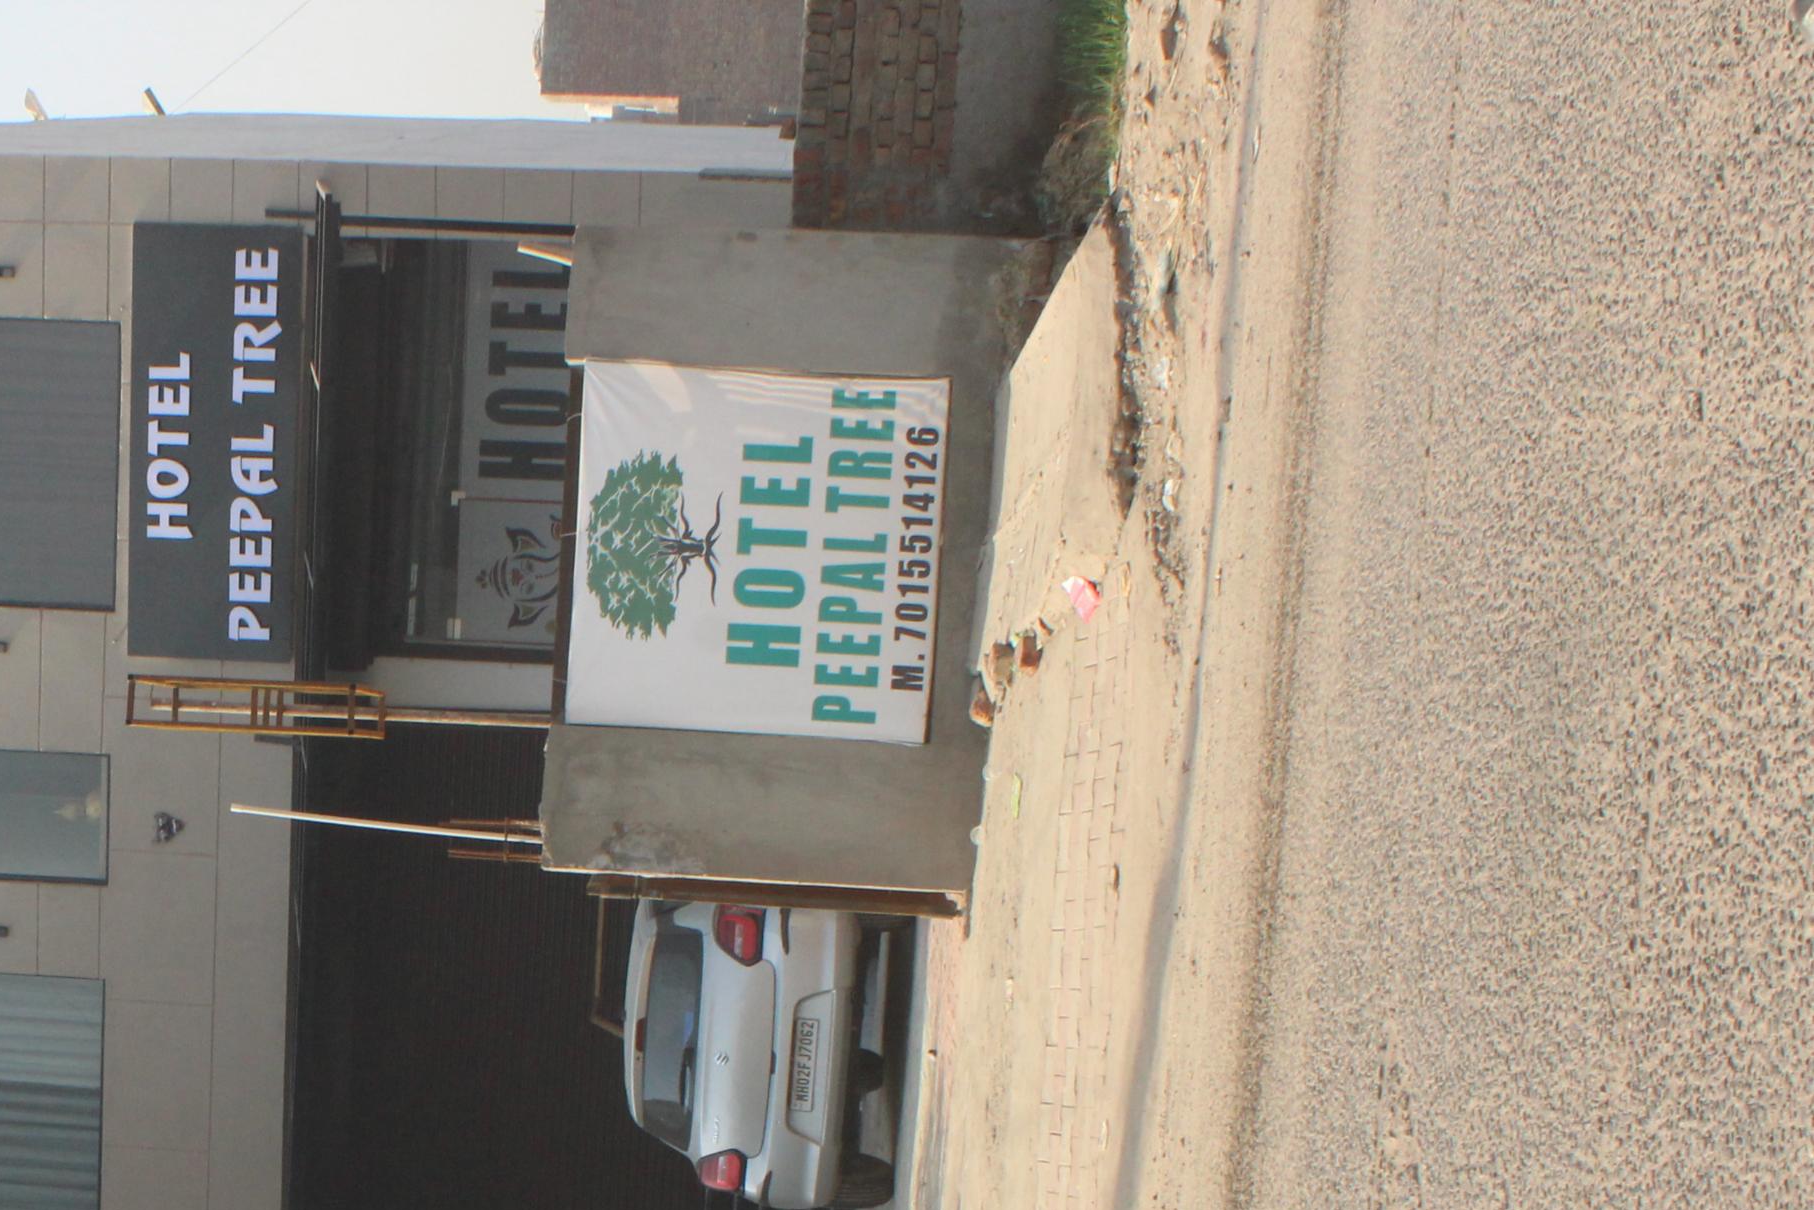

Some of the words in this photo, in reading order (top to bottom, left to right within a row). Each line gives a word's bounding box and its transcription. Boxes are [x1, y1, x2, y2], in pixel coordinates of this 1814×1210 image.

[231, 247, 283, 404] TREE
[478, 263, 570, 480] HOTEL
[146, 352, 194, 539] HOTEL
[228, 423, 279, 641] PEEPAL
[825, 388, 897, 513] TREE
[893, 427, 939, 641] 7015514126
[725, 436, 814, 668] HOTEL
[811, 533, 888, 724] PEEPAL
[890, 654, 926, 691] M.
